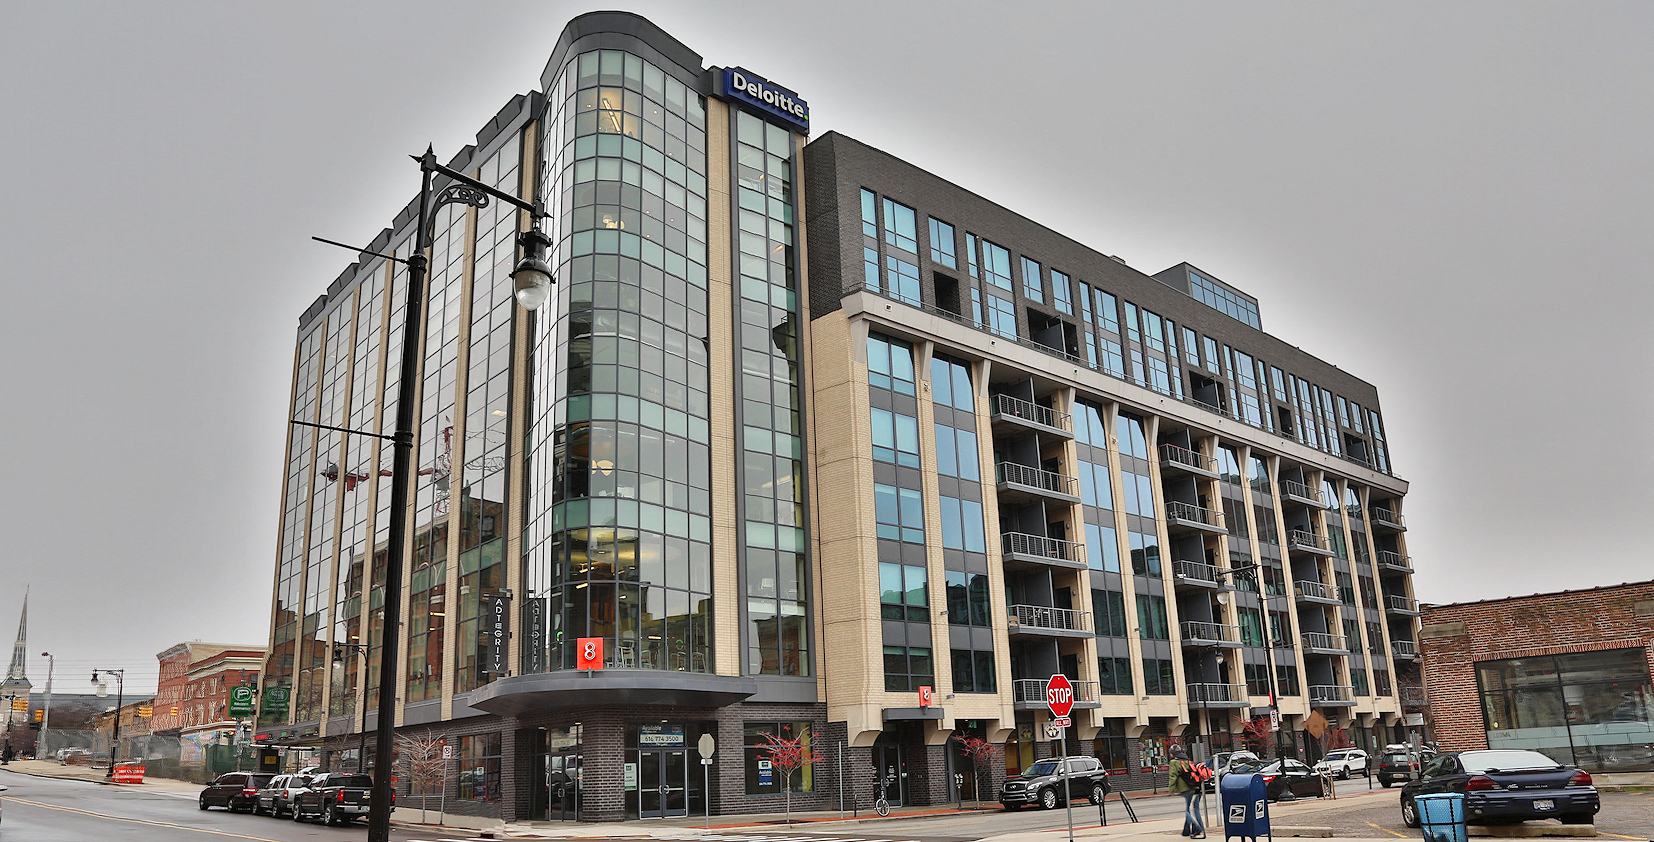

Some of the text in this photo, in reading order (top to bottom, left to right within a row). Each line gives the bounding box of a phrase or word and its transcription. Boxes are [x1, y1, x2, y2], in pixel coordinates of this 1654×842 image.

[494, 598, 503, 671] ADTEGRITY
[584, 642, 596, 660] 8
[924, 689, 930, 700] 8
[1048, 687, 1071, 704] STOP
